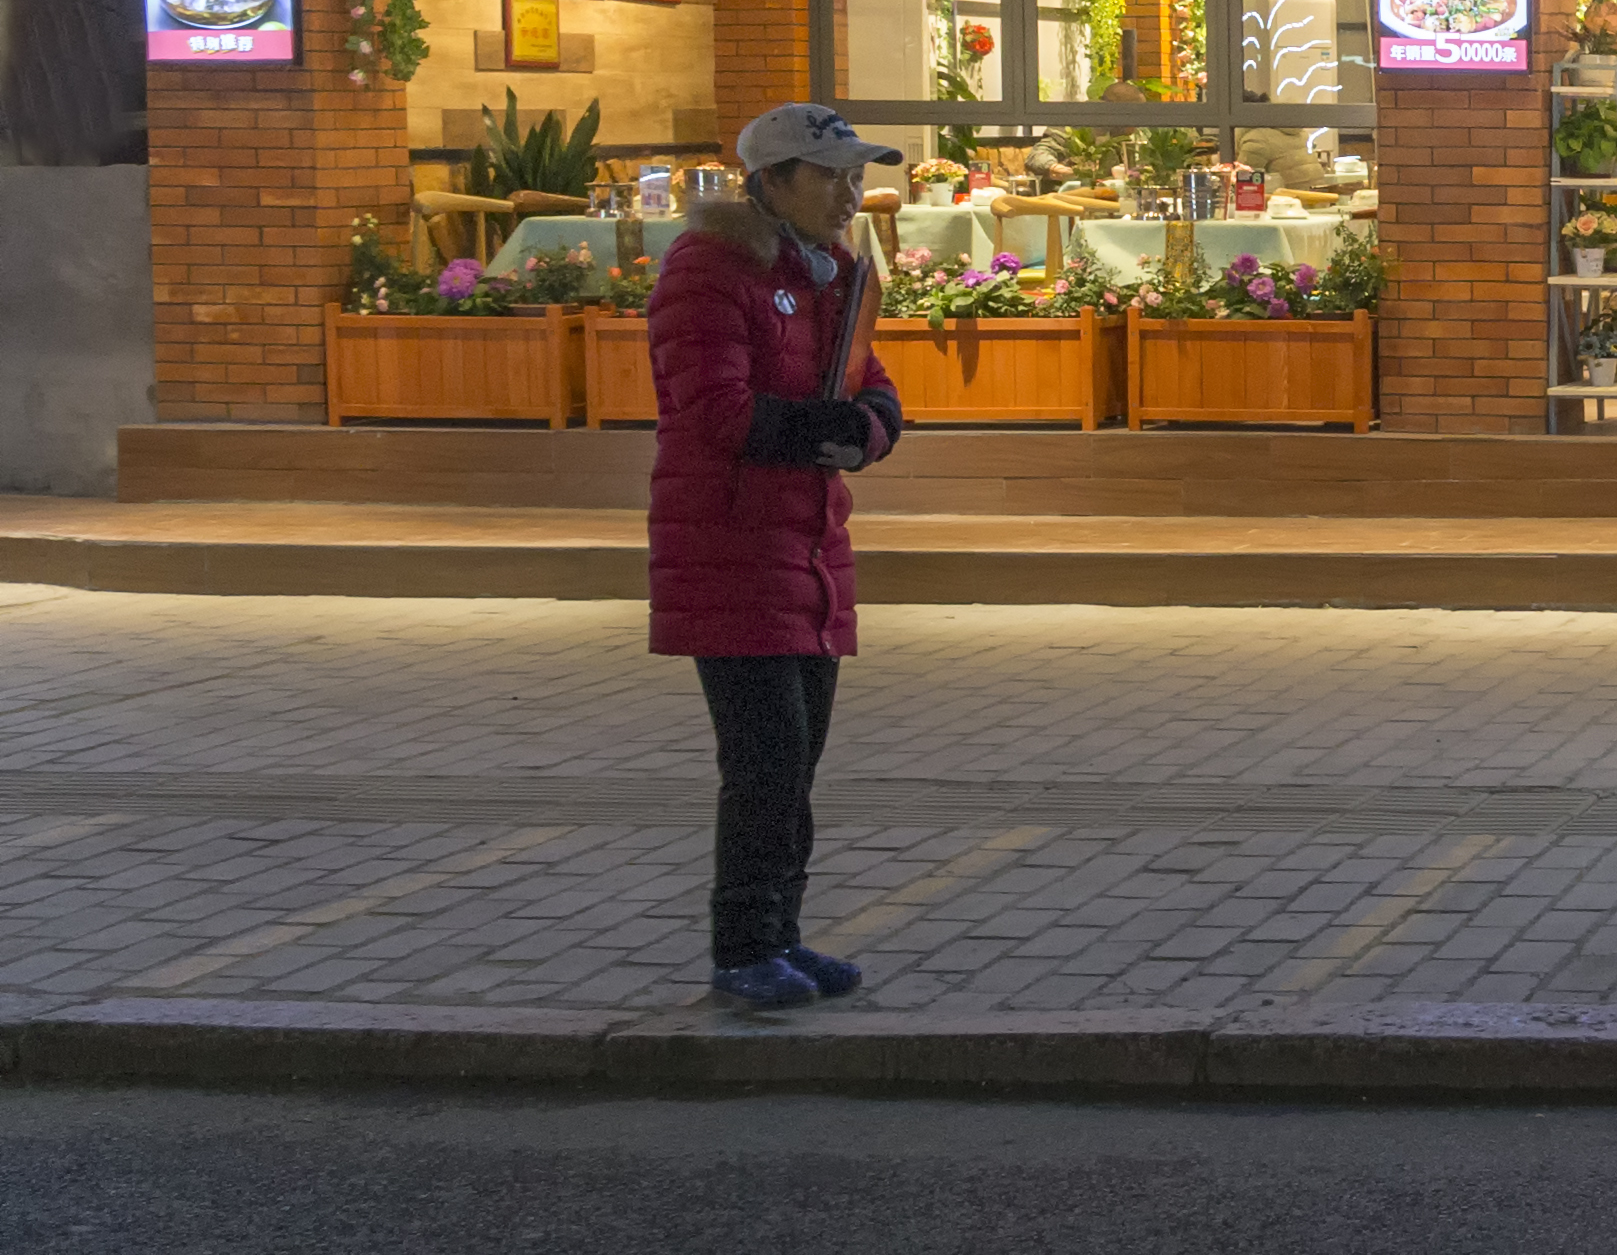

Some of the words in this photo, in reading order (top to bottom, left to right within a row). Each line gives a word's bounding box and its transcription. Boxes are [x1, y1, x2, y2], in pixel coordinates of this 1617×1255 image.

[187, 33, 254, 54] 特别推荐
[1390, 31, 1517, 64] 年销量50000条
